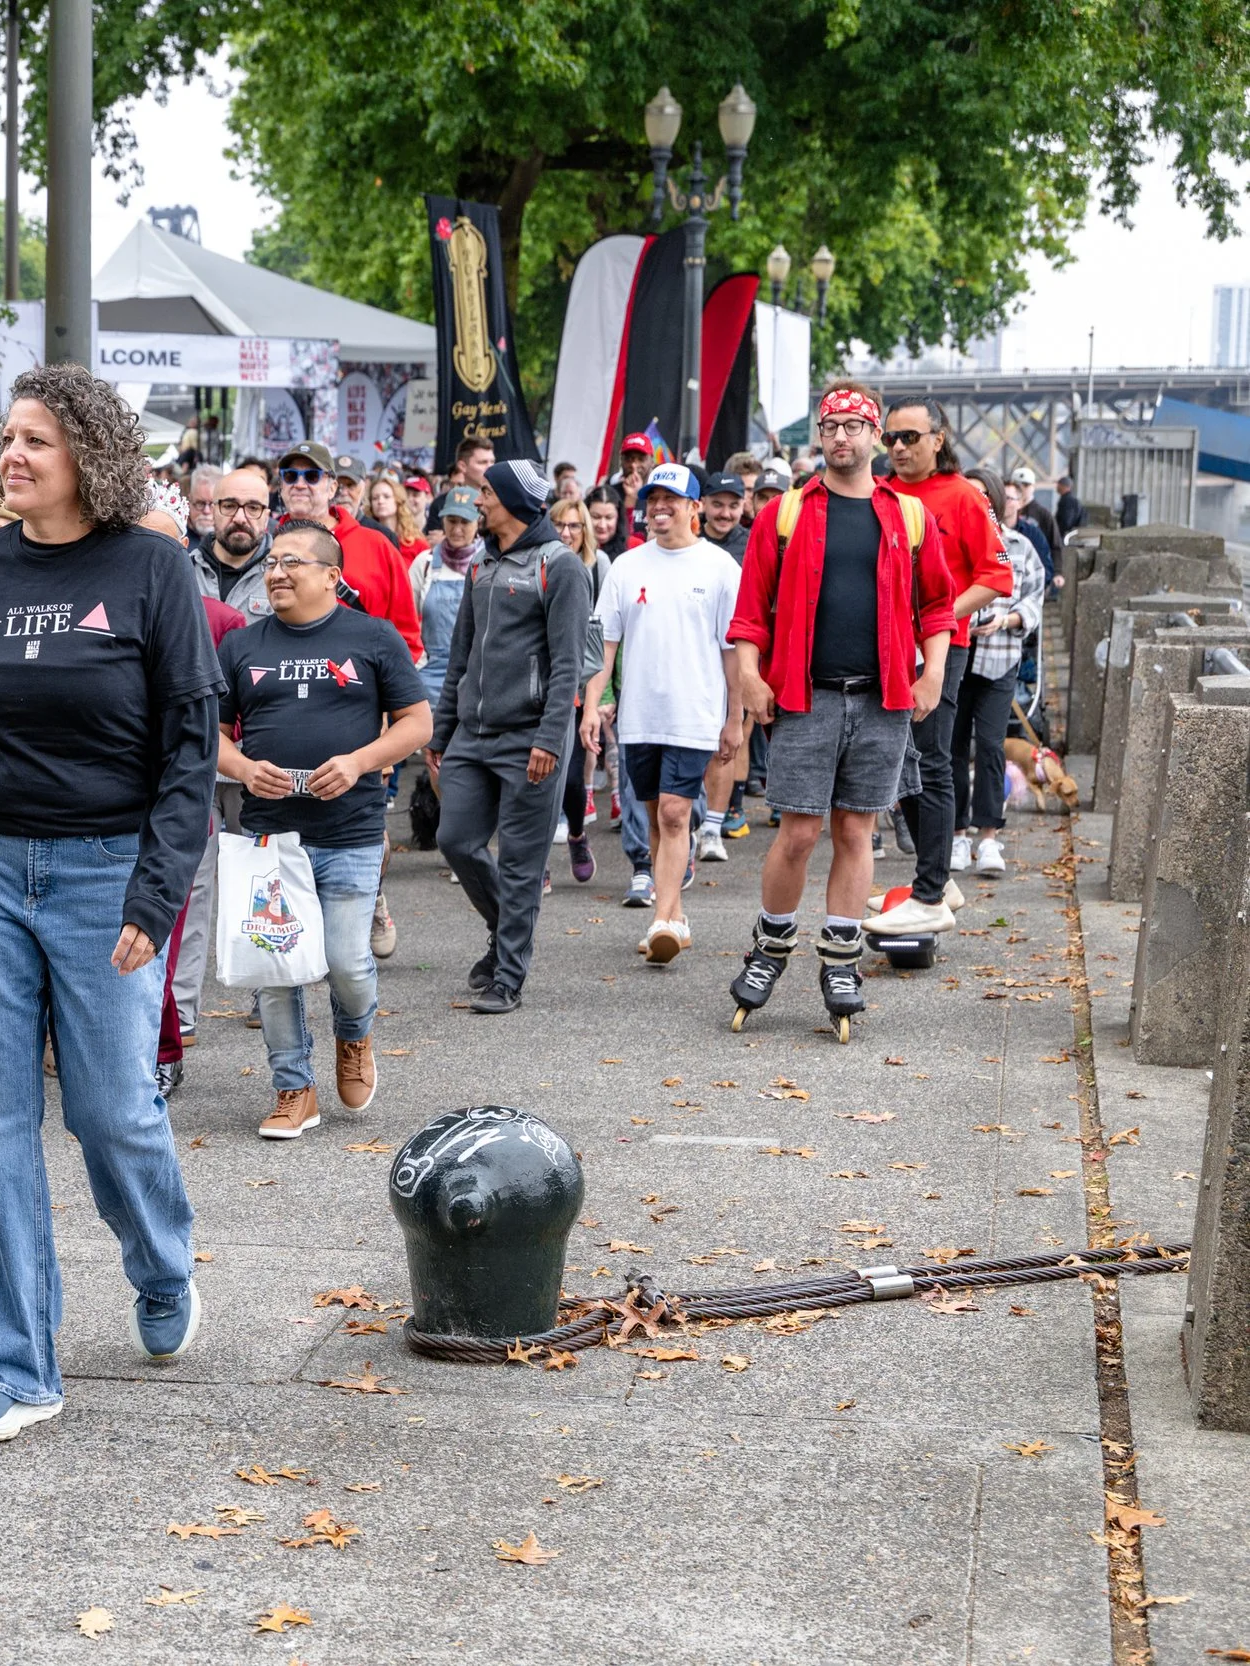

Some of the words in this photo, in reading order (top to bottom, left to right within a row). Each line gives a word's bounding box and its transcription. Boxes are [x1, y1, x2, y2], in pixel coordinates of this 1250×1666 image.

[452, 401, 477, 420] Gay
[7, 607, 25, 615] ALL
[26, 604, 58, 614] WALKS
[59, 603, 73, 611] OF
[3, 612, 71, 637] LIFE
[279, 664, 329, 680] LIFE
